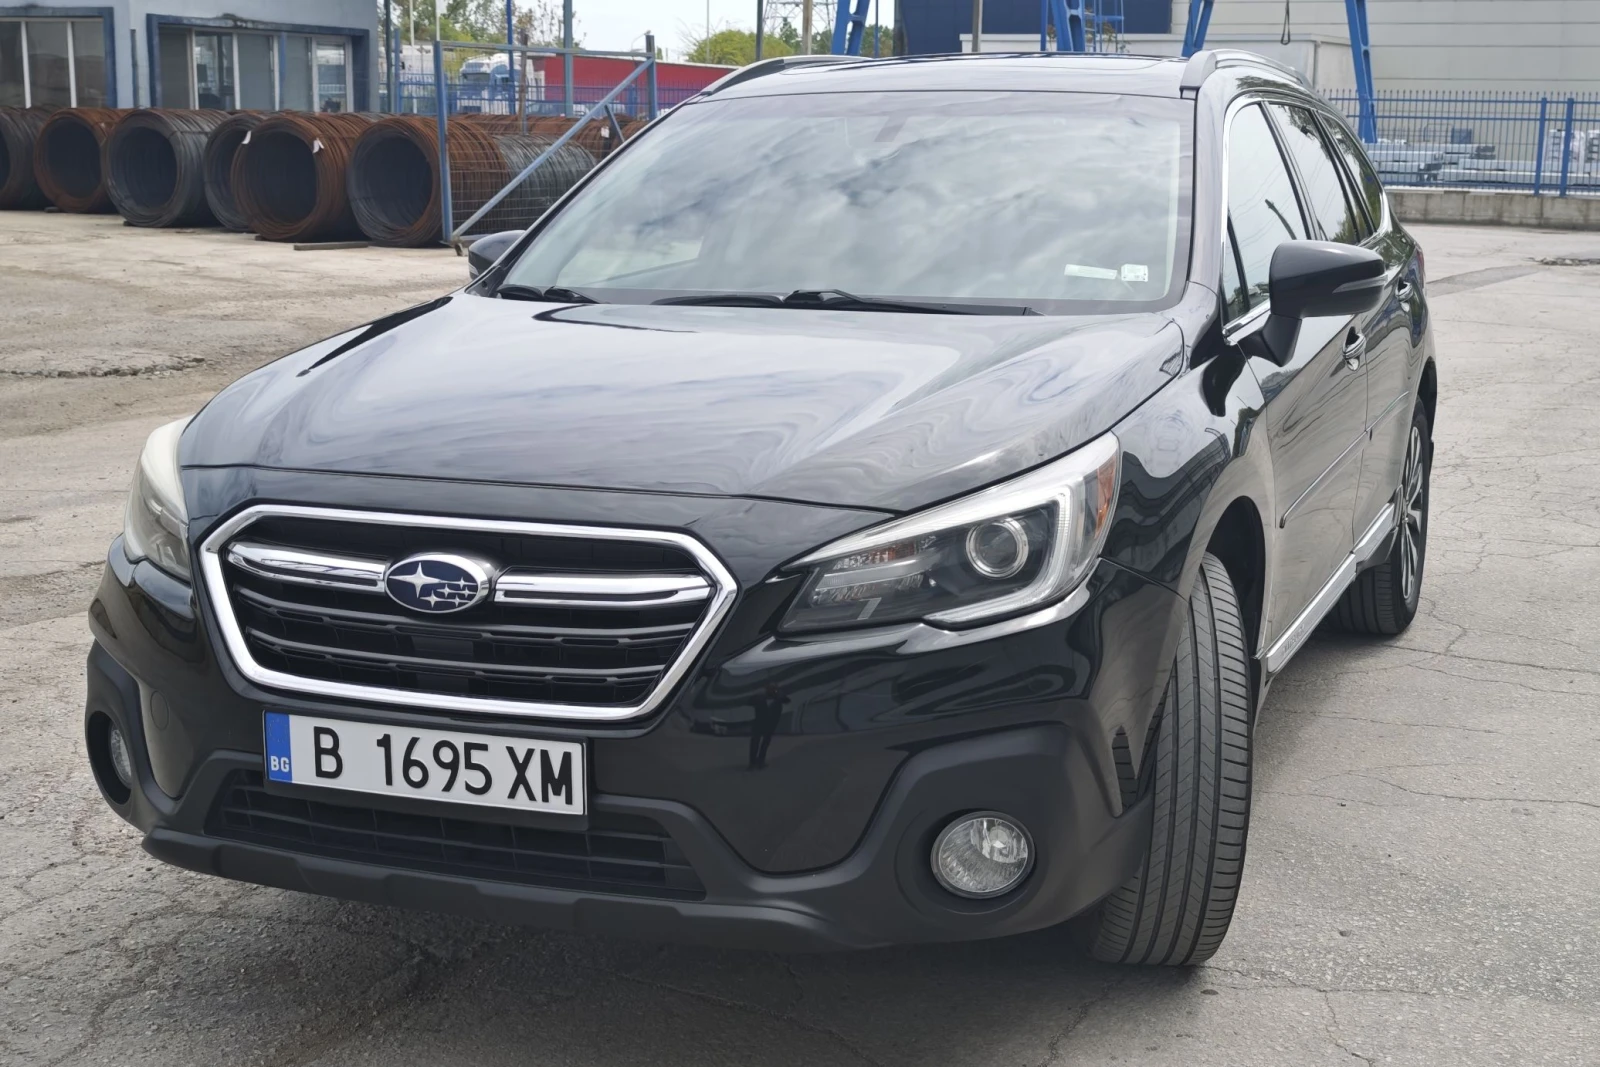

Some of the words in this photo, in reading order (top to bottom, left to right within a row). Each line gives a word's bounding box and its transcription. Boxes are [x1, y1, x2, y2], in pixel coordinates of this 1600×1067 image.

[270, 755, 290, 773] BG
[313, 726, 344, 779] B
[376, 733, 493, 796] 1695
[505, 745, 573, 805] XM
